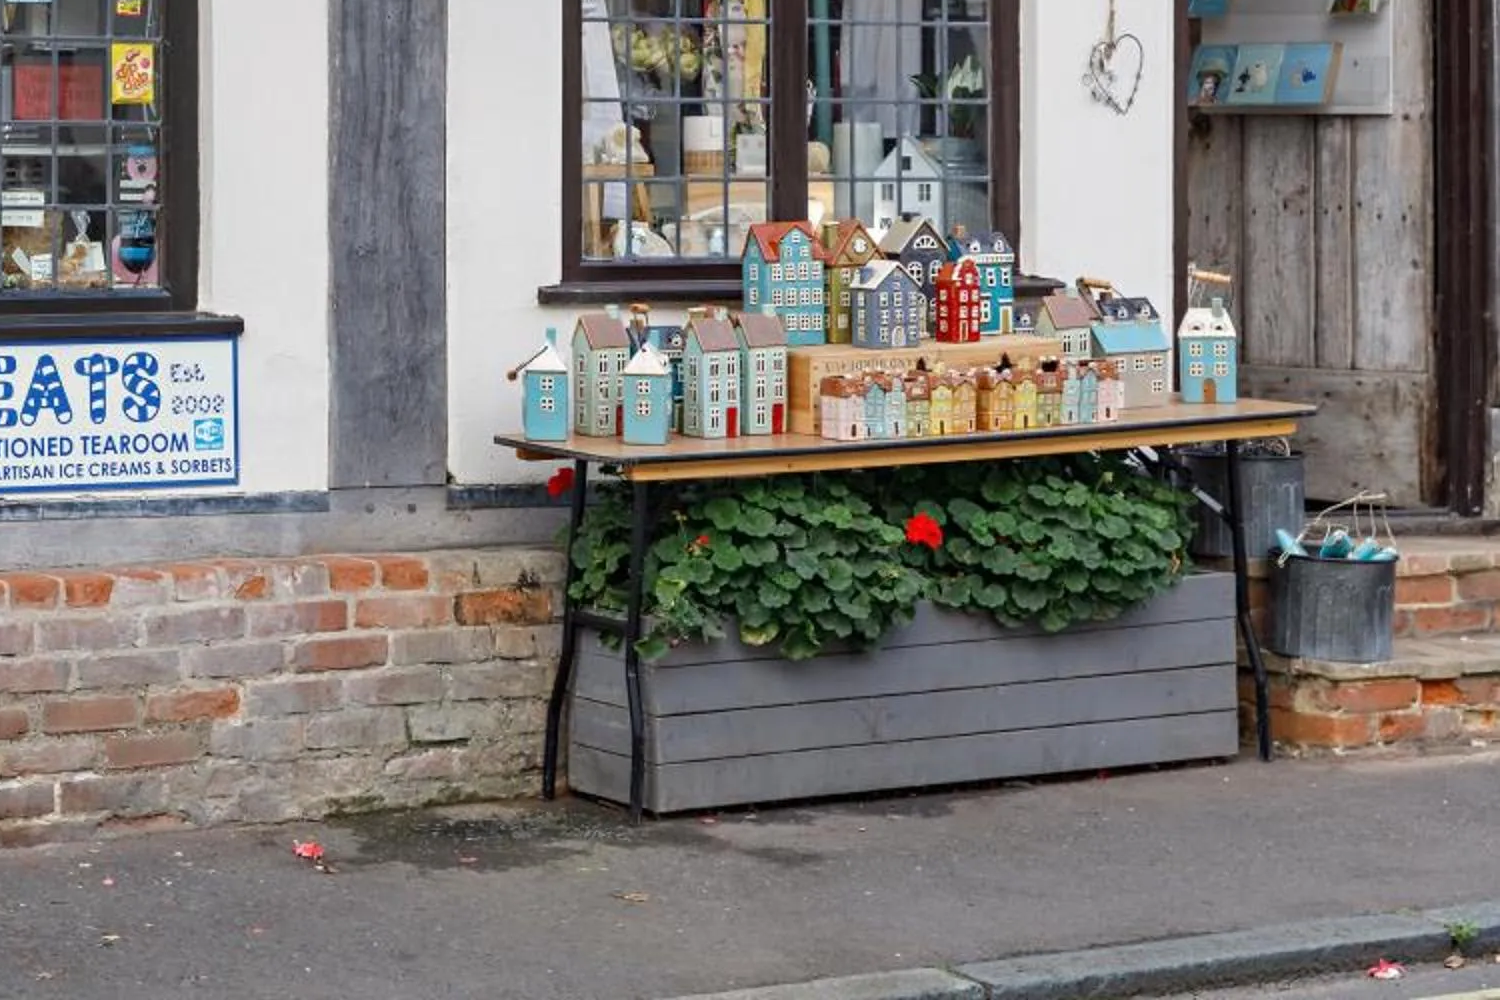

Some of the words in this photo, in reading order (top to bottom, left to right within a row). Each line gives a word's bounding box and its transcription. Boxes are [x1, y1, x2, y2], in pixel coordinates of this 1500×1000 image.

[171, 394, 225, 415] 2002
[80, 432, 190, 456] TEAROOM
[59, 463, 85, 478] ICE
[89, 460, 151, 477] CREAMS
[155, 460, 166, 475] &
[171, 457, 233, 474] SORBETS
